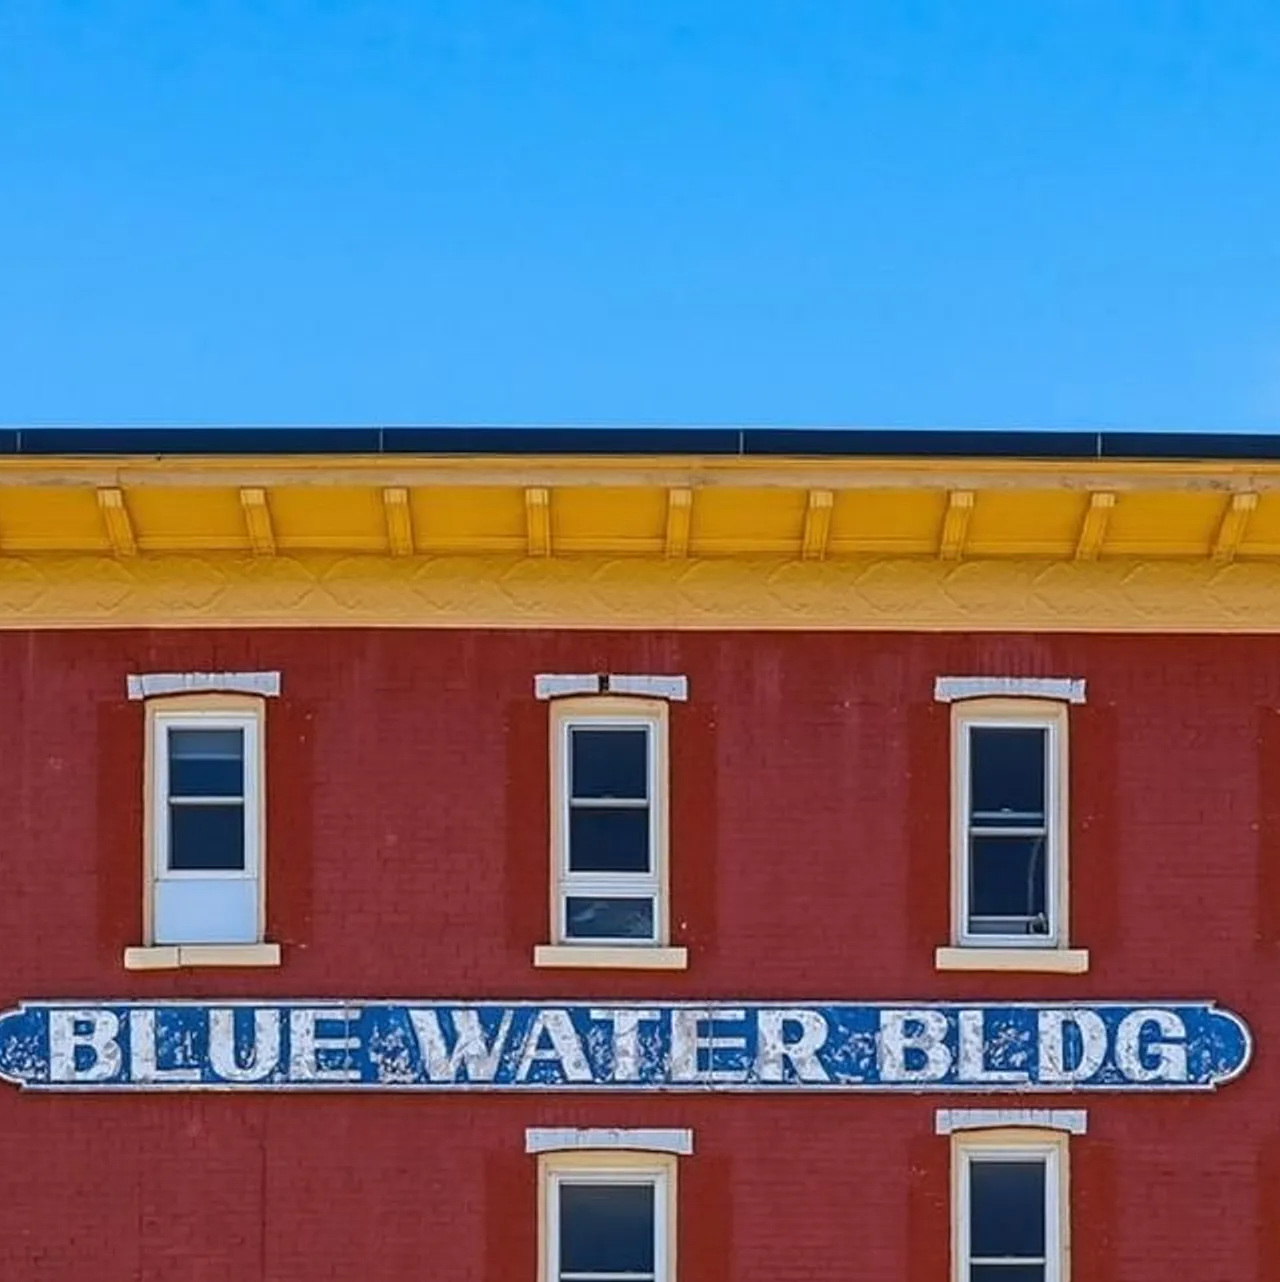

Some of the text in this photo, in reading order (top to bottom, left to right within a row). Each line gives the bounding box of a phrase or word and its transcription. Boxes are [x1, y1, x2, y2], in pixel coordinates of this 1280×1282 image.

[49, 1008, 1188, 1083] BLUE WATER BLDG
